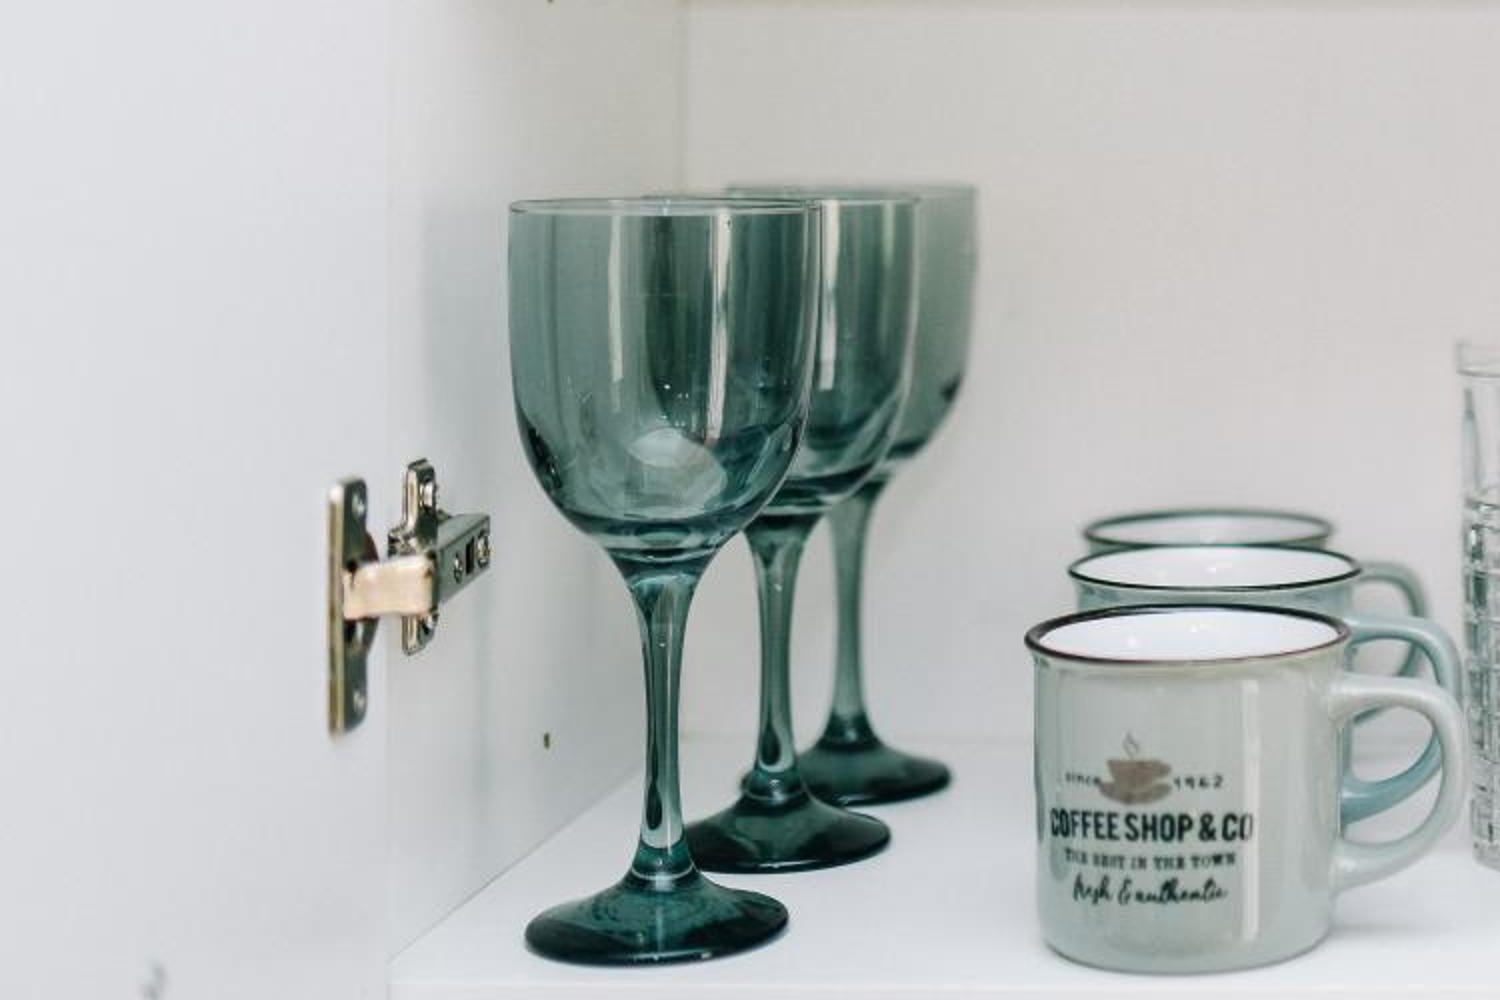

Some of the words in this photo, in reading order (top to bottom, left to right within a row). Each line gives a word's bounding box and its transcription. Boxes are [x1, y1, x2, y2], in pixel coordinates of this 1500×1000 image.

[1064, 772, 1102, 788] since
[1172, 774, 1224, 790] 1962
[1050, 807, 1121, 842] COFFEE
[1124, 811, 1194, 842] SHOP
[1197, 812, 1218, 842] &
[1221, 812, 1255, 842] CO
[1064, 847, 1089, 866] THE
[1130, 854, 1148, 871] IN
[1152, 855, 1185, 871] THE
[1190, 851, 1237, 869] TOWN
